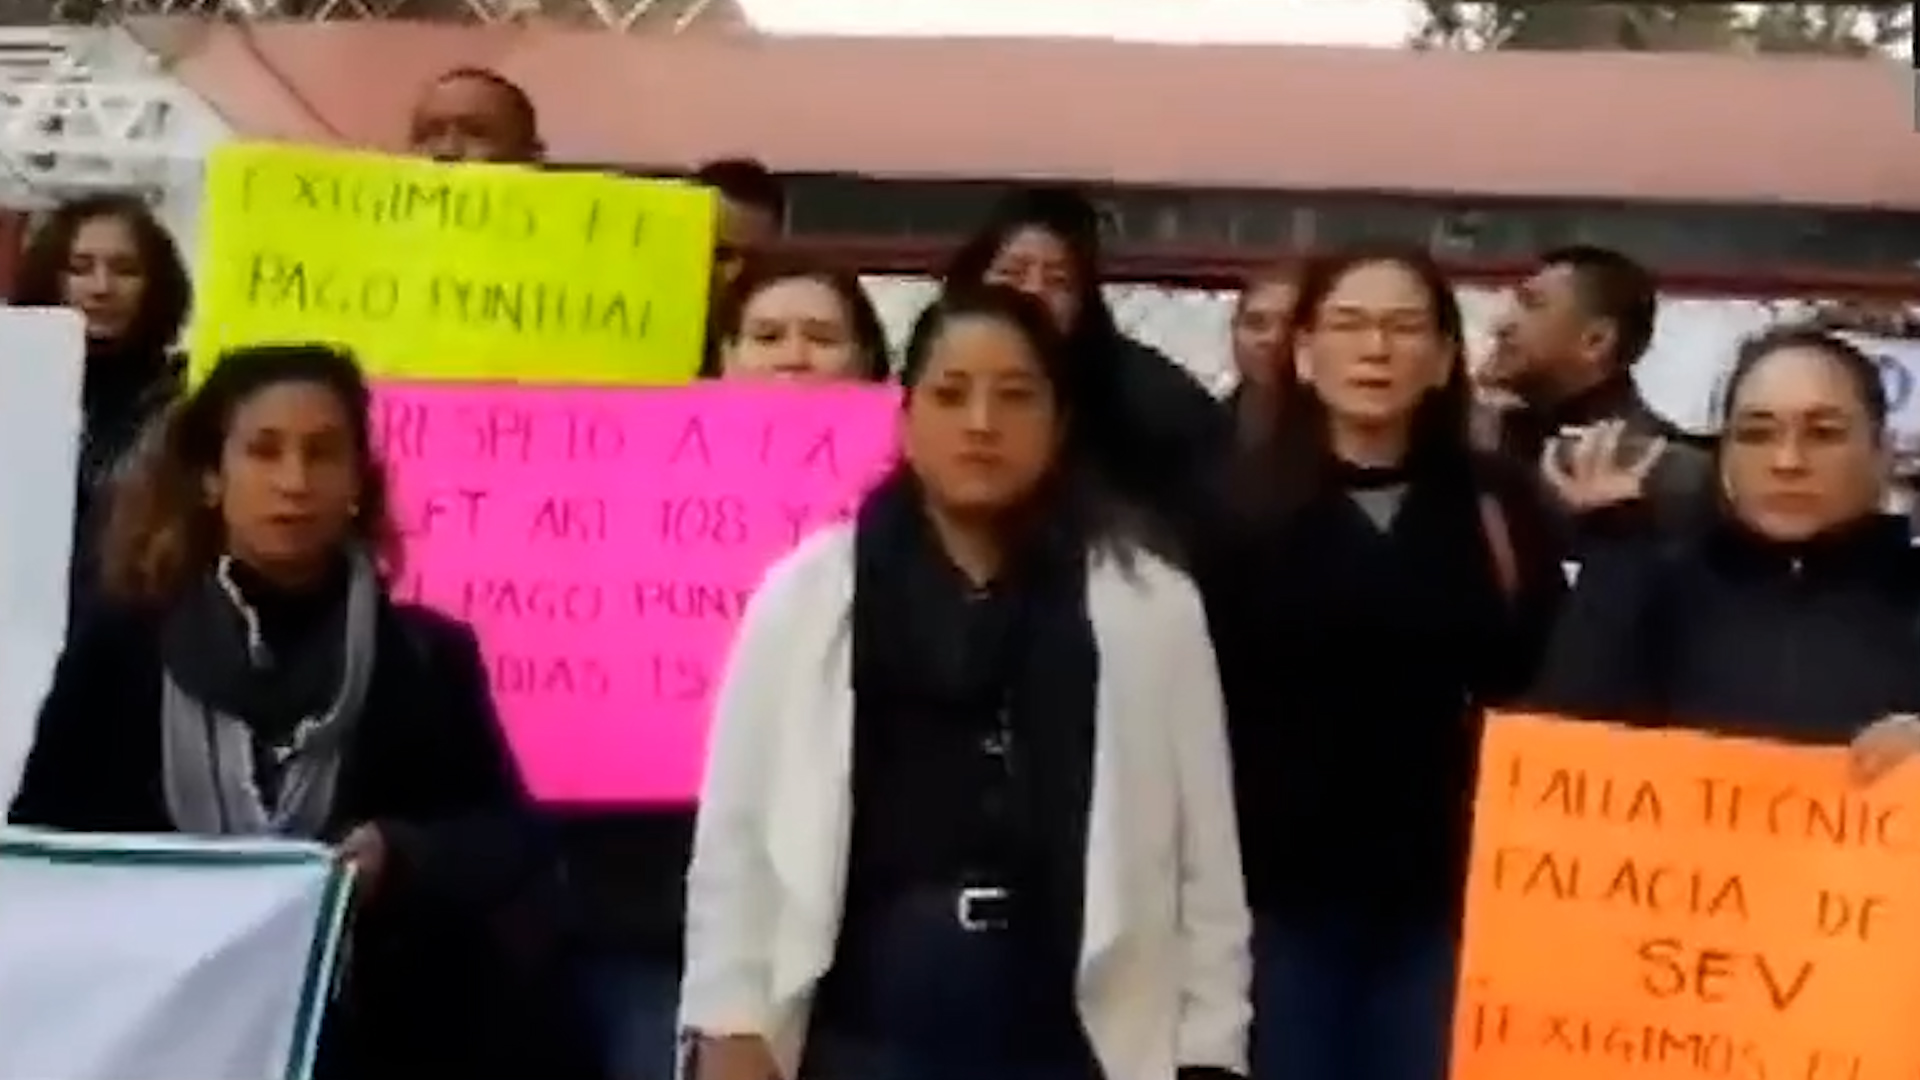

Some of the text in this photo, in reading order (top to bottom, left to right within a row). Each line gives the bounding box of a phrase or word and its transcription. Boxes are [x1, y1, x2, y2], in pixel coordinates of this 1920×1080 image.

[247, 252, 399, 320] PAGO
[669, 414, 712, 466] A
[660, 496, 748, 544] 108
[463, 578, 602, 622] PAGO
[1493, 847, 1888, 942] FALACIA DE
[1637, 936, 1816, 1012] SEV
